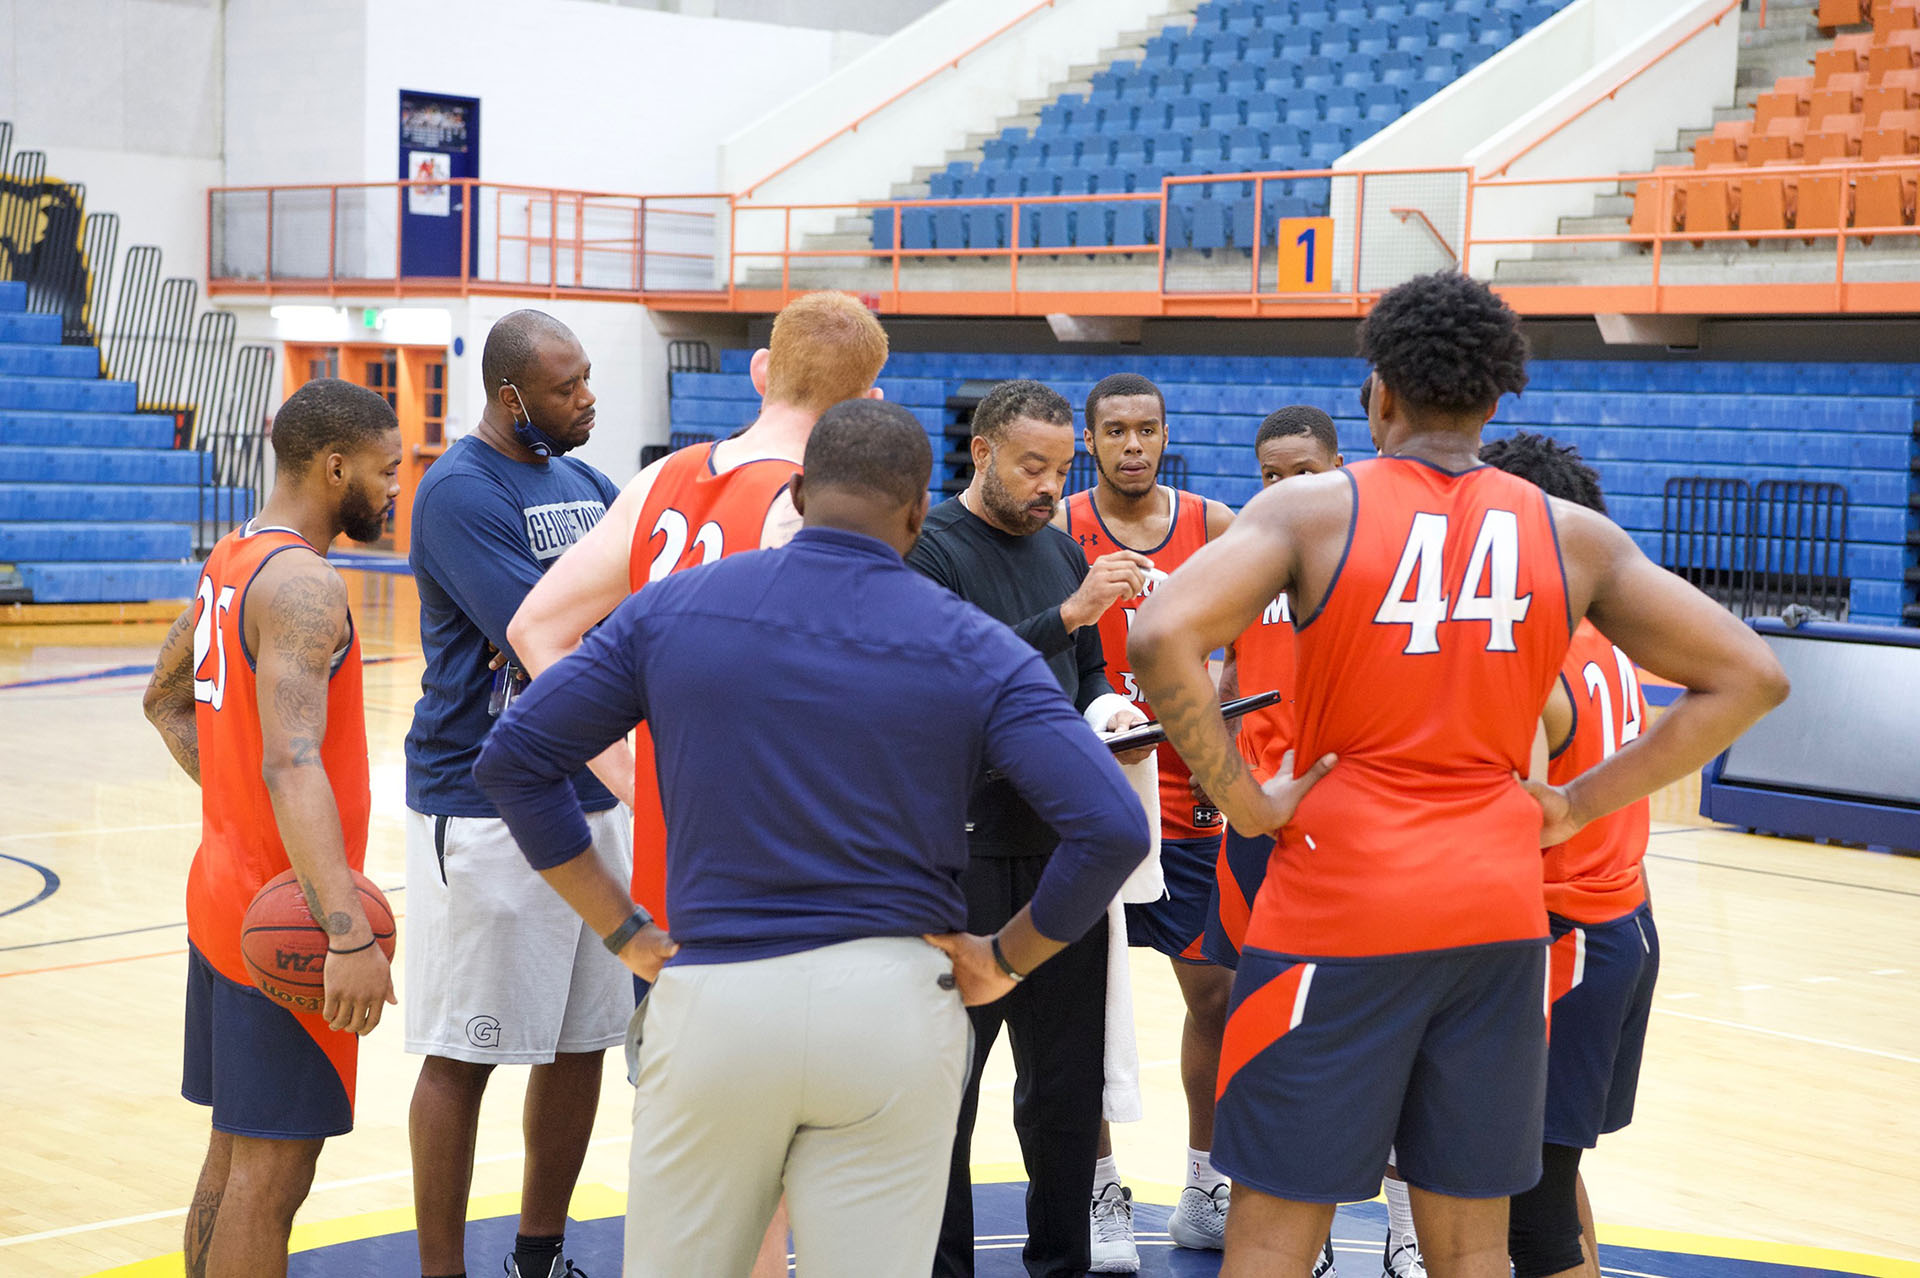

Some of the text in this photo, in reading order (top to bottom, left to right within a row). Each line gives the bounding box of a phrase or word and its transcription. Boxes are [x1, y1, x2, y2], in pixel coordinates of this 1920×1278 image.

[1297, 228, 1315, 283] 1
[1372, 508, 1533, 656] 44
[193, 573, 236, 712] 25
[465, 1015, 502, 1048] G
